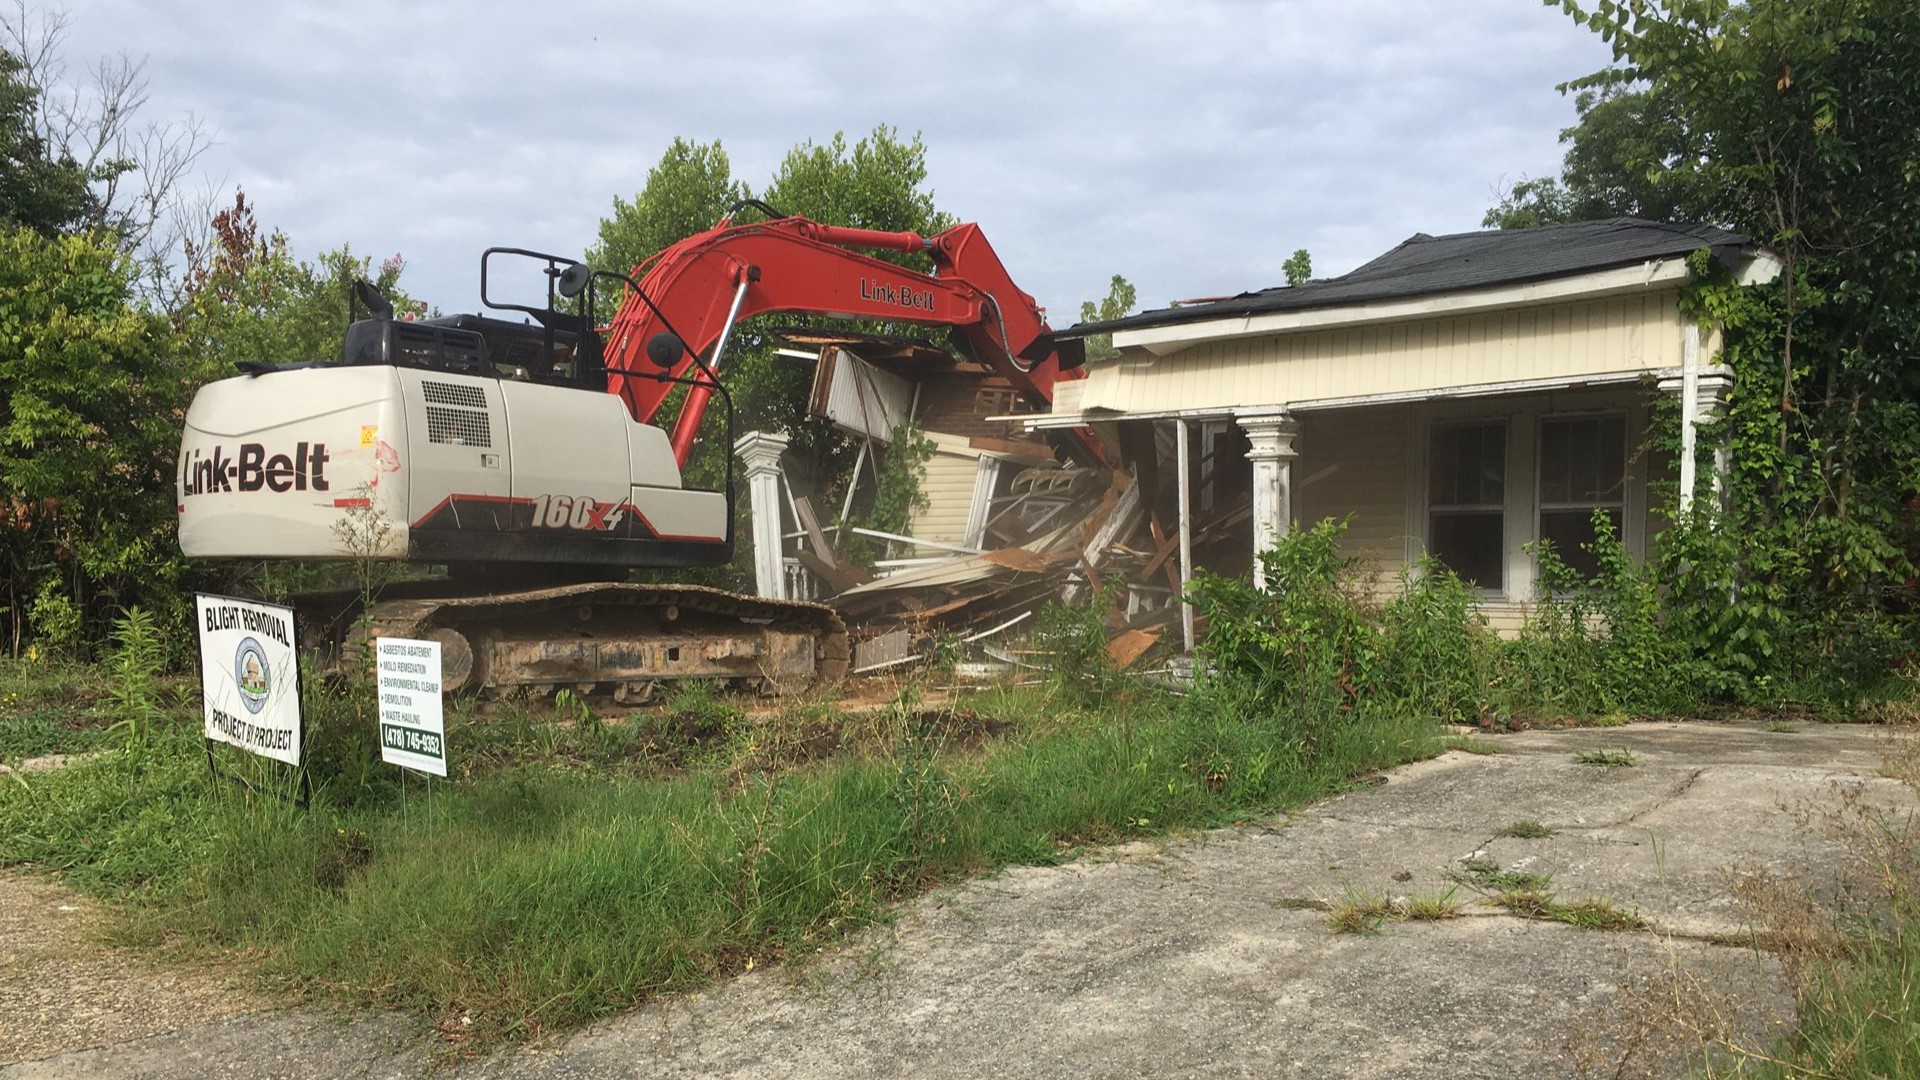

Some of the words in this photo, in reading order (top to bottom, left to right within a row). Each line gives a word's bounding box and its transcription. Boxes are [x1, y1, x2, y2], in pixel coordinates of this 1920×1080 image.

[861, 278, 934, 312] Link-Belt
[184, 442, 329, 496] Link-Belt
[206, 606, 240, 632] BLIGHT
[241, 608, 290, 648] REMOVAL
[383, 645, 406, 656] ASBESTOS
[407, 646, 432, 658] ABATEMENT
[383, 661, 397, 672] MOLD
[397, 662, 427, 675] REMEDIATION
[384, 677, 419, 690] ENVIRONMENTAL
[384, 694, 411, 706] DEMOLITION
[385, 710, 401, 722] WASTE
[401, 713, 421, 725] HAULING
[213, 708, 246, 740] PROJECT
[254, 725, 292, 751] PROJECT
[385, 725, 404, 749] (478)
[406, 731, 440, 755] 745-9352
